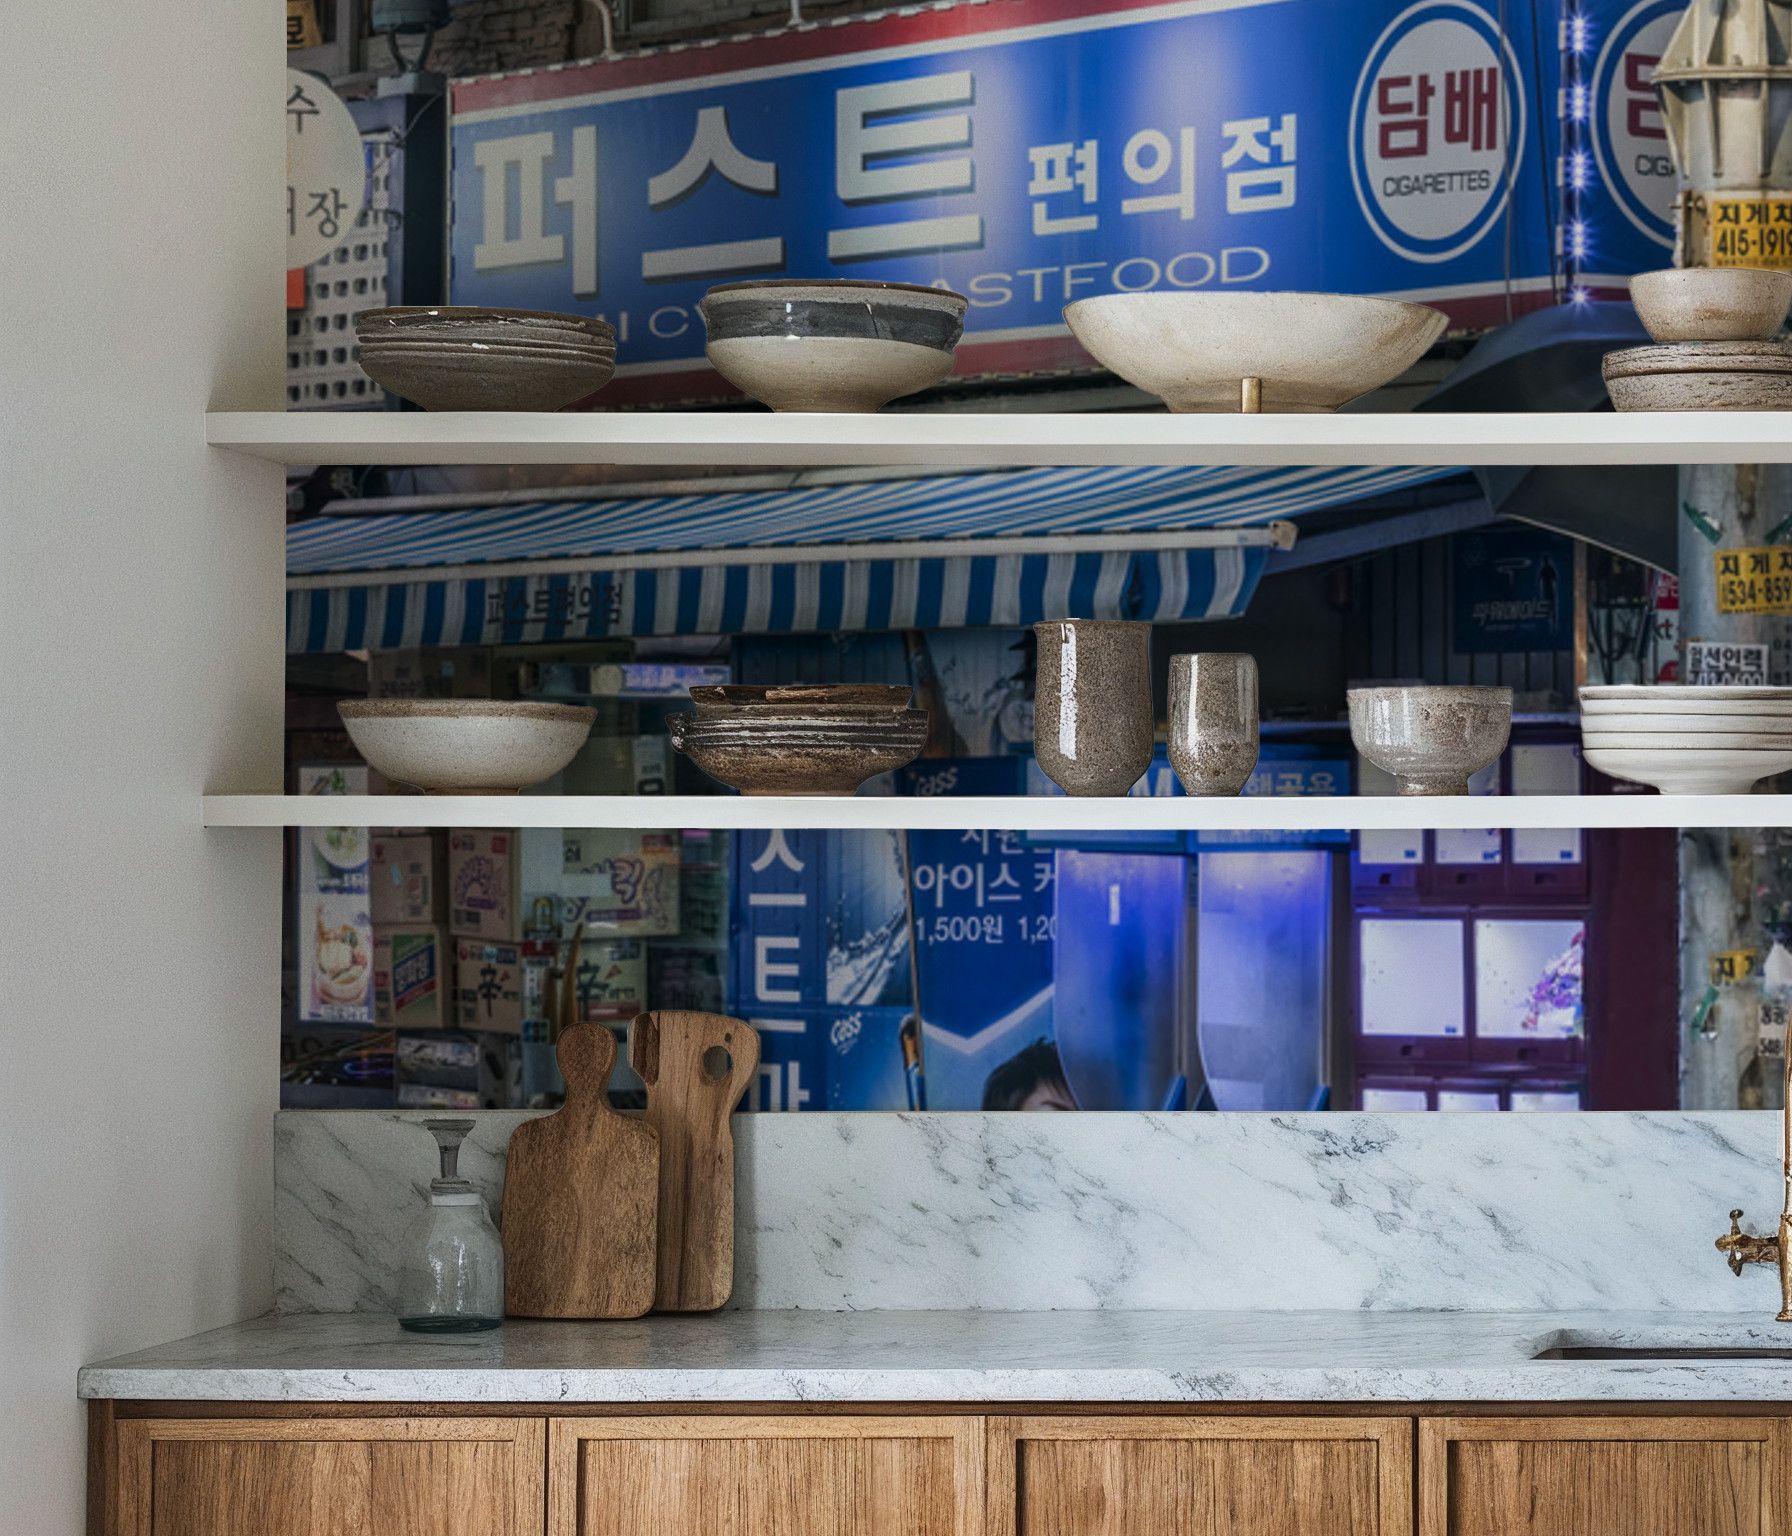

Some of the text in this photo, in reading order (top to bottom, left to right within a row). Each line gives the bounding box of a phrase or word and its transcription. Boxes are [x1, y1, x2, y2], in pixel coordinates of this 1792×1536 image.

[1377, 66, 1498, 160] 담배
[473, 71, 1298, 296] 퍼스트 편의점
[1383, 169, 1490, 197] CIGARETTES
[485, 583, 623, 627] 퍼스트편의점
[915, 861, 1023, 906] 아이스
[915, 915, 1004, 947] 1,500원
